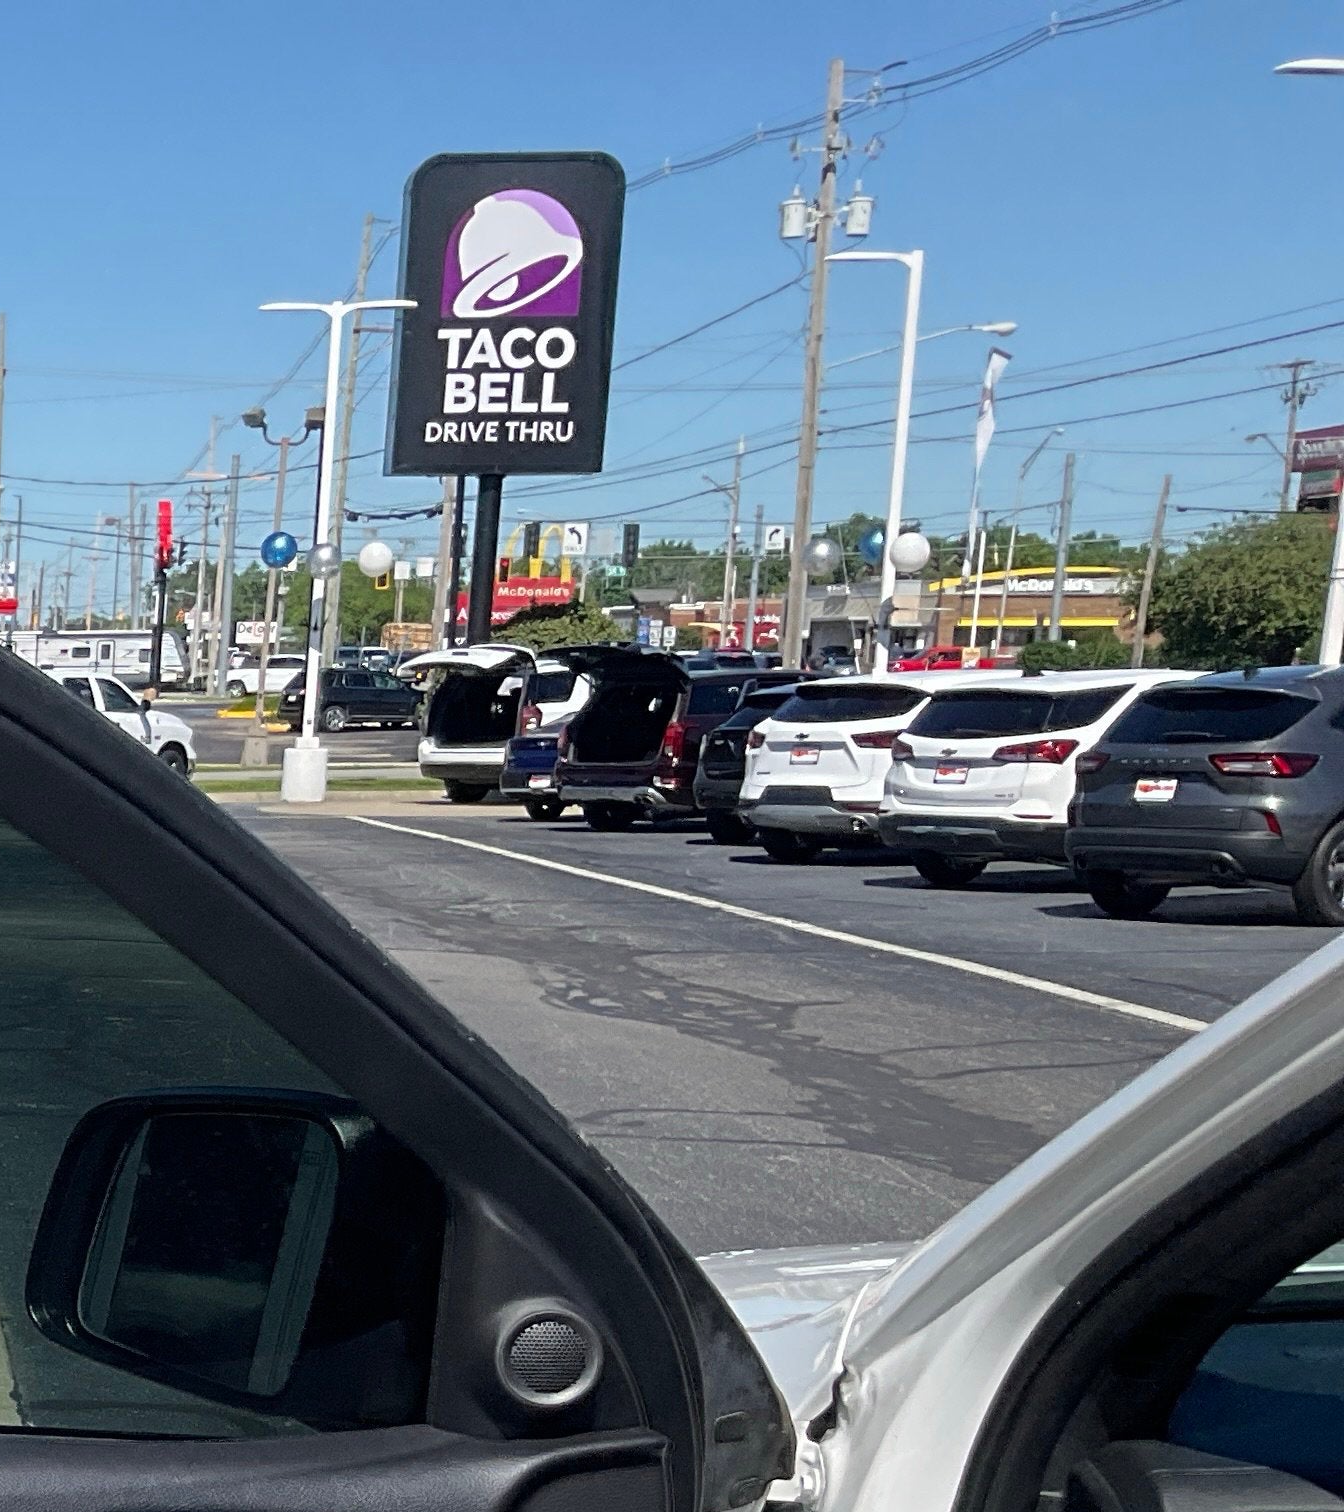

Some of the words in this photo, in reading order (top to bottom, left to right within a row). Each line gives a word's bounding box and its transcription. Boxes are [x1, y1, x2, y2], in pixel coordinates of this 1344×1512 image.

[437, 327, 576, 370] TACO
[443, 372, 569, 414] BELL
[424, 421, 498, 443] DRIVE
[506, 420, 573, 443] THRU
[497, 586, 570, 597] McDonald's
